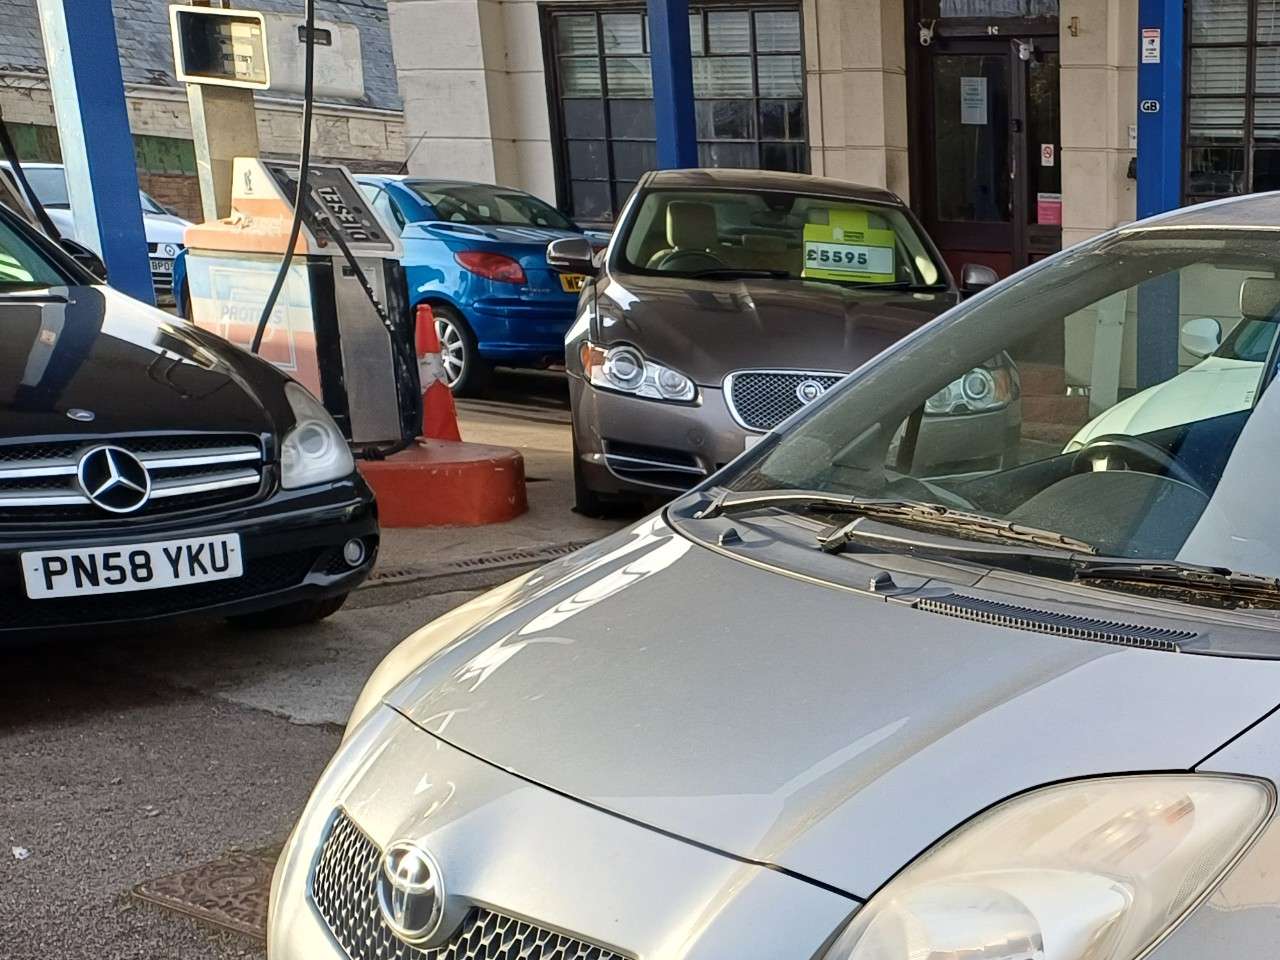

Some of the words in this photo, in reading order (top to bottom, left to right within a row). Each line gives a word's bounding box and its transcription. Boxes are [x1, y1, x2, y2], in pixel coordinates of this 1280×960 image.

[1142, 101, 1158, 111] GB
[317, 186, 369, 241] DIESEL
[806, 249, 868, 265] £5595
[41, 550, 154, 590] PN58
[162, 540, 229, 579] YKU
